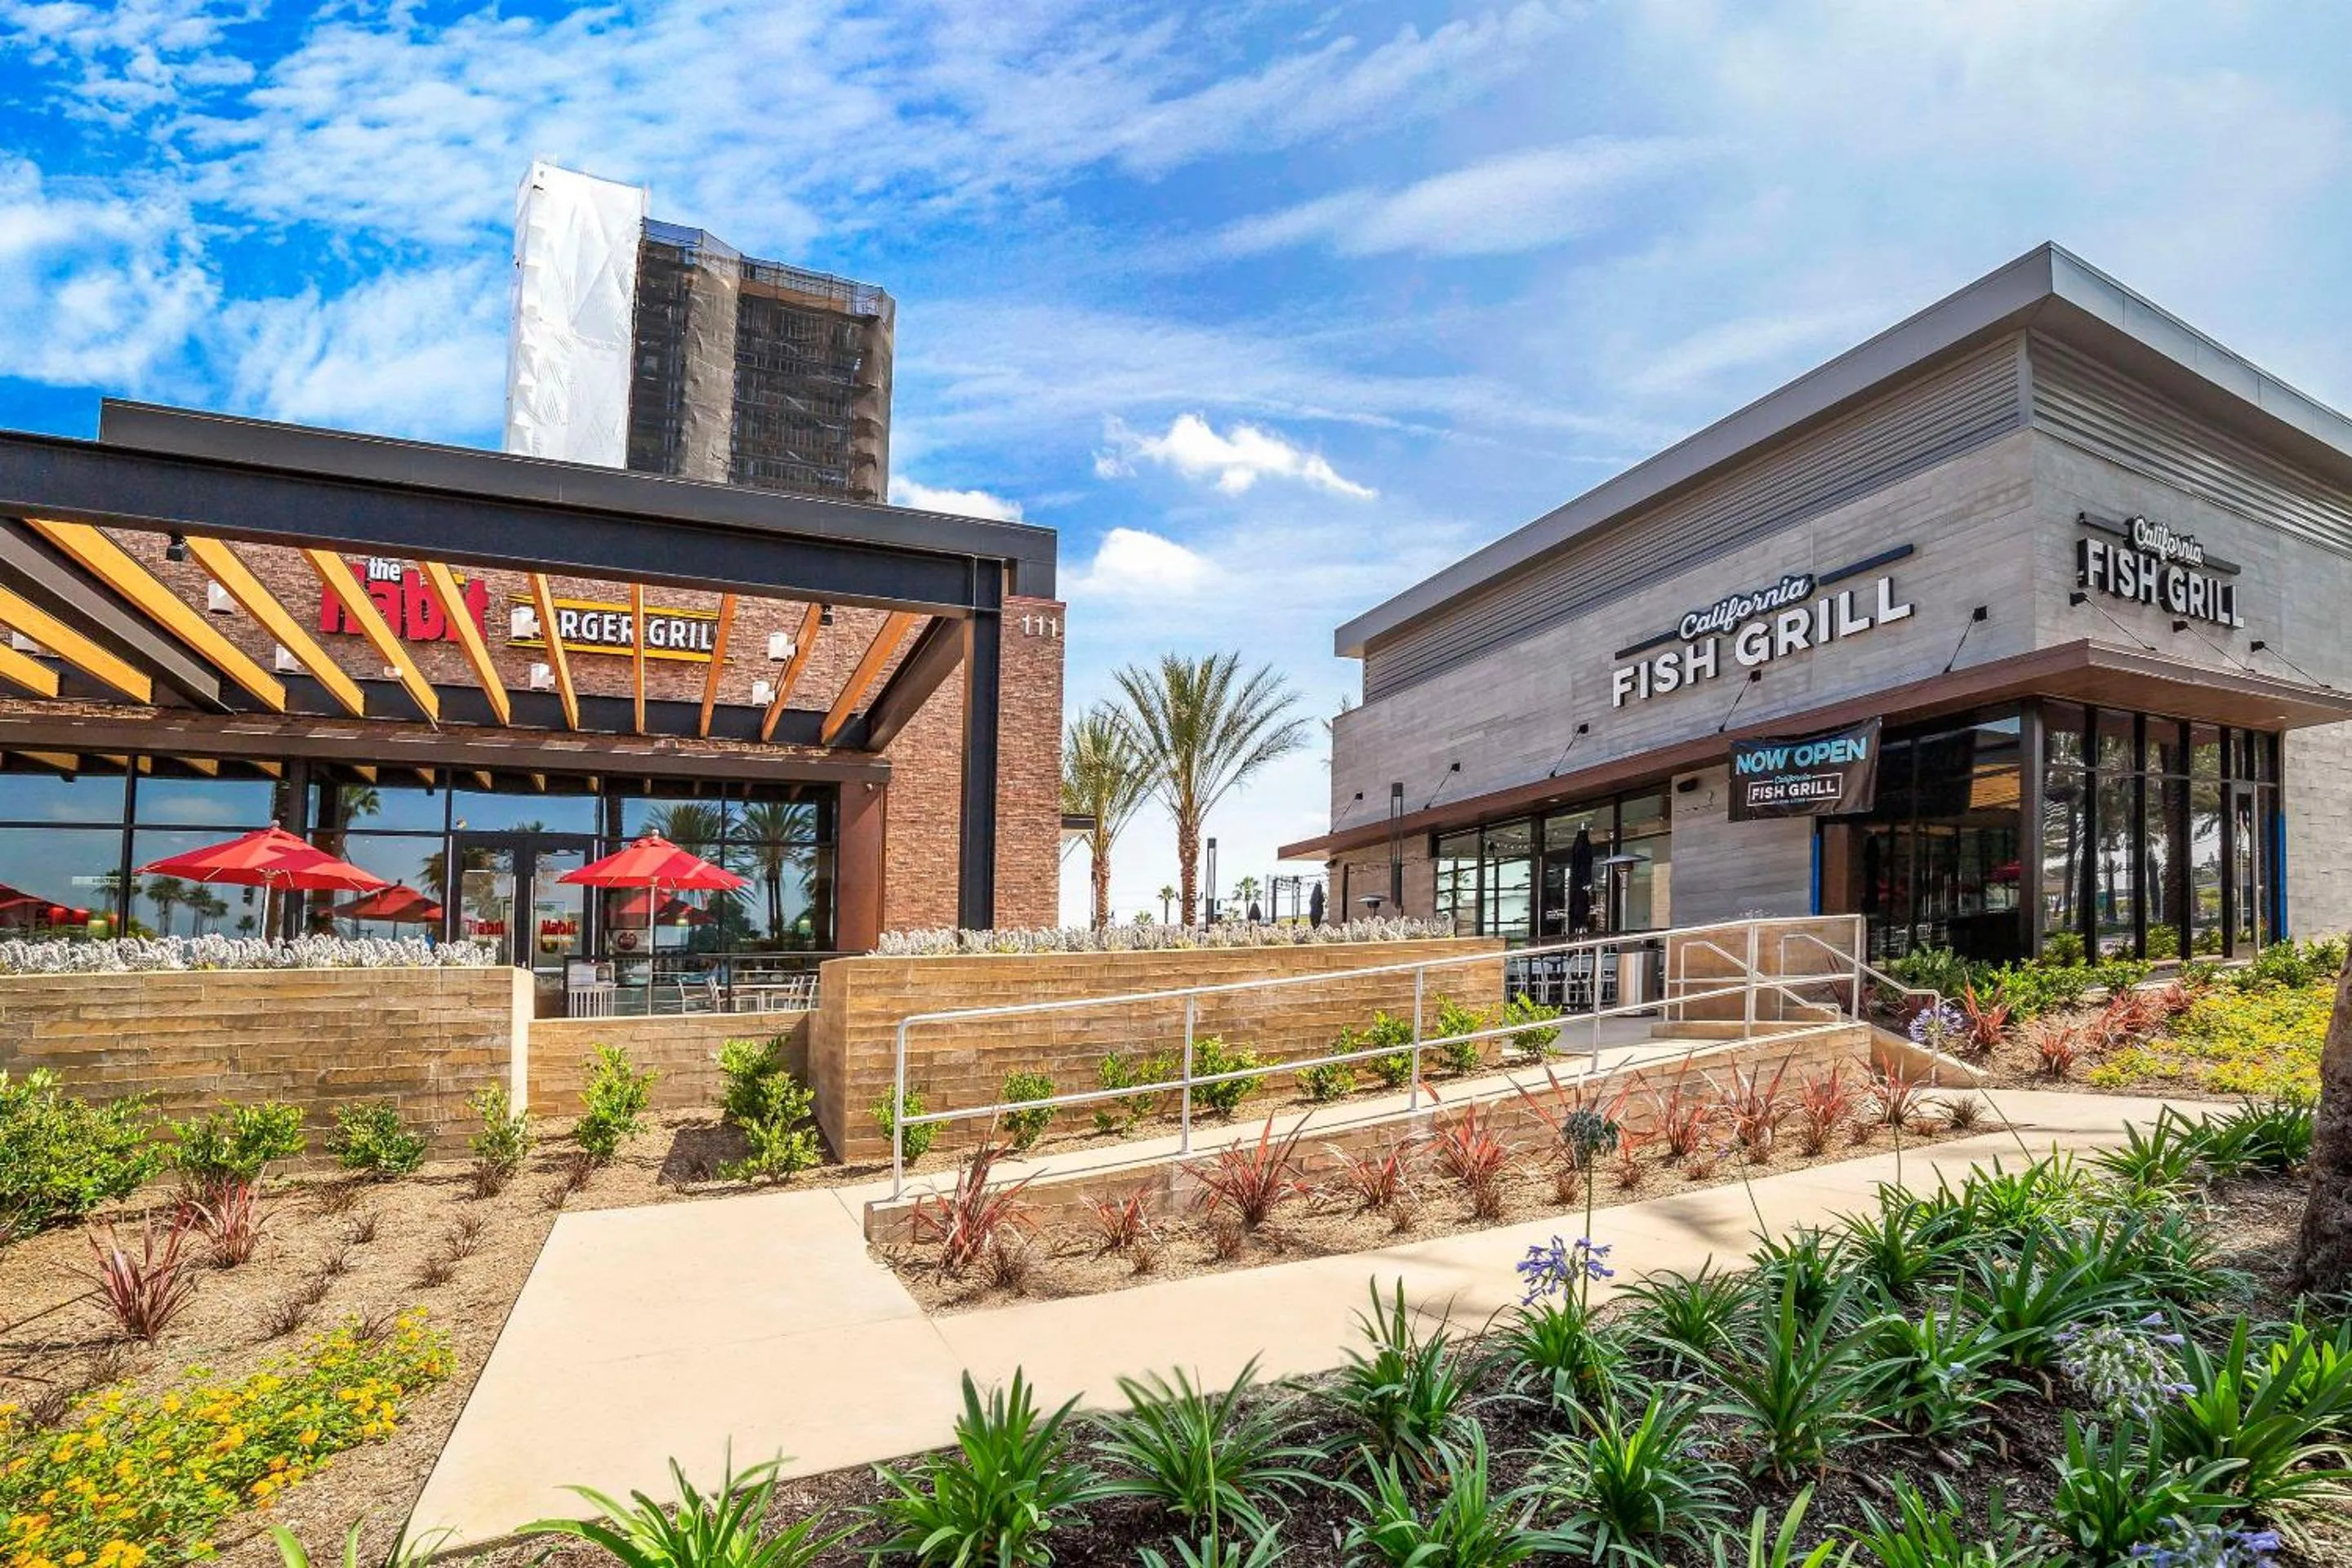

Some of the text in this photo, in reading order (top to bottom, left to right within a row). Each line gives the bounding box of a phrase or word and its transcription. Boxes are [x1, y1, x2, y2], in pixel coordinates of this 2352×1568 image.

[2131, 516, 2204, 564] California
[368, 557, 401, 581] the
[2084, 537, 2245, 629] FISH GRILL
[1022, 613, 1057, 638] 111
[1680, 575, 1810, 641] California
[542, 610, 717, 651] RGER GRIL
[1612, 576, 1913, 708] FISH GRILL
[1735, 736, 1868, 776] NOW OPEN
[1751, 780, 1836, 801] FISH GRILL
